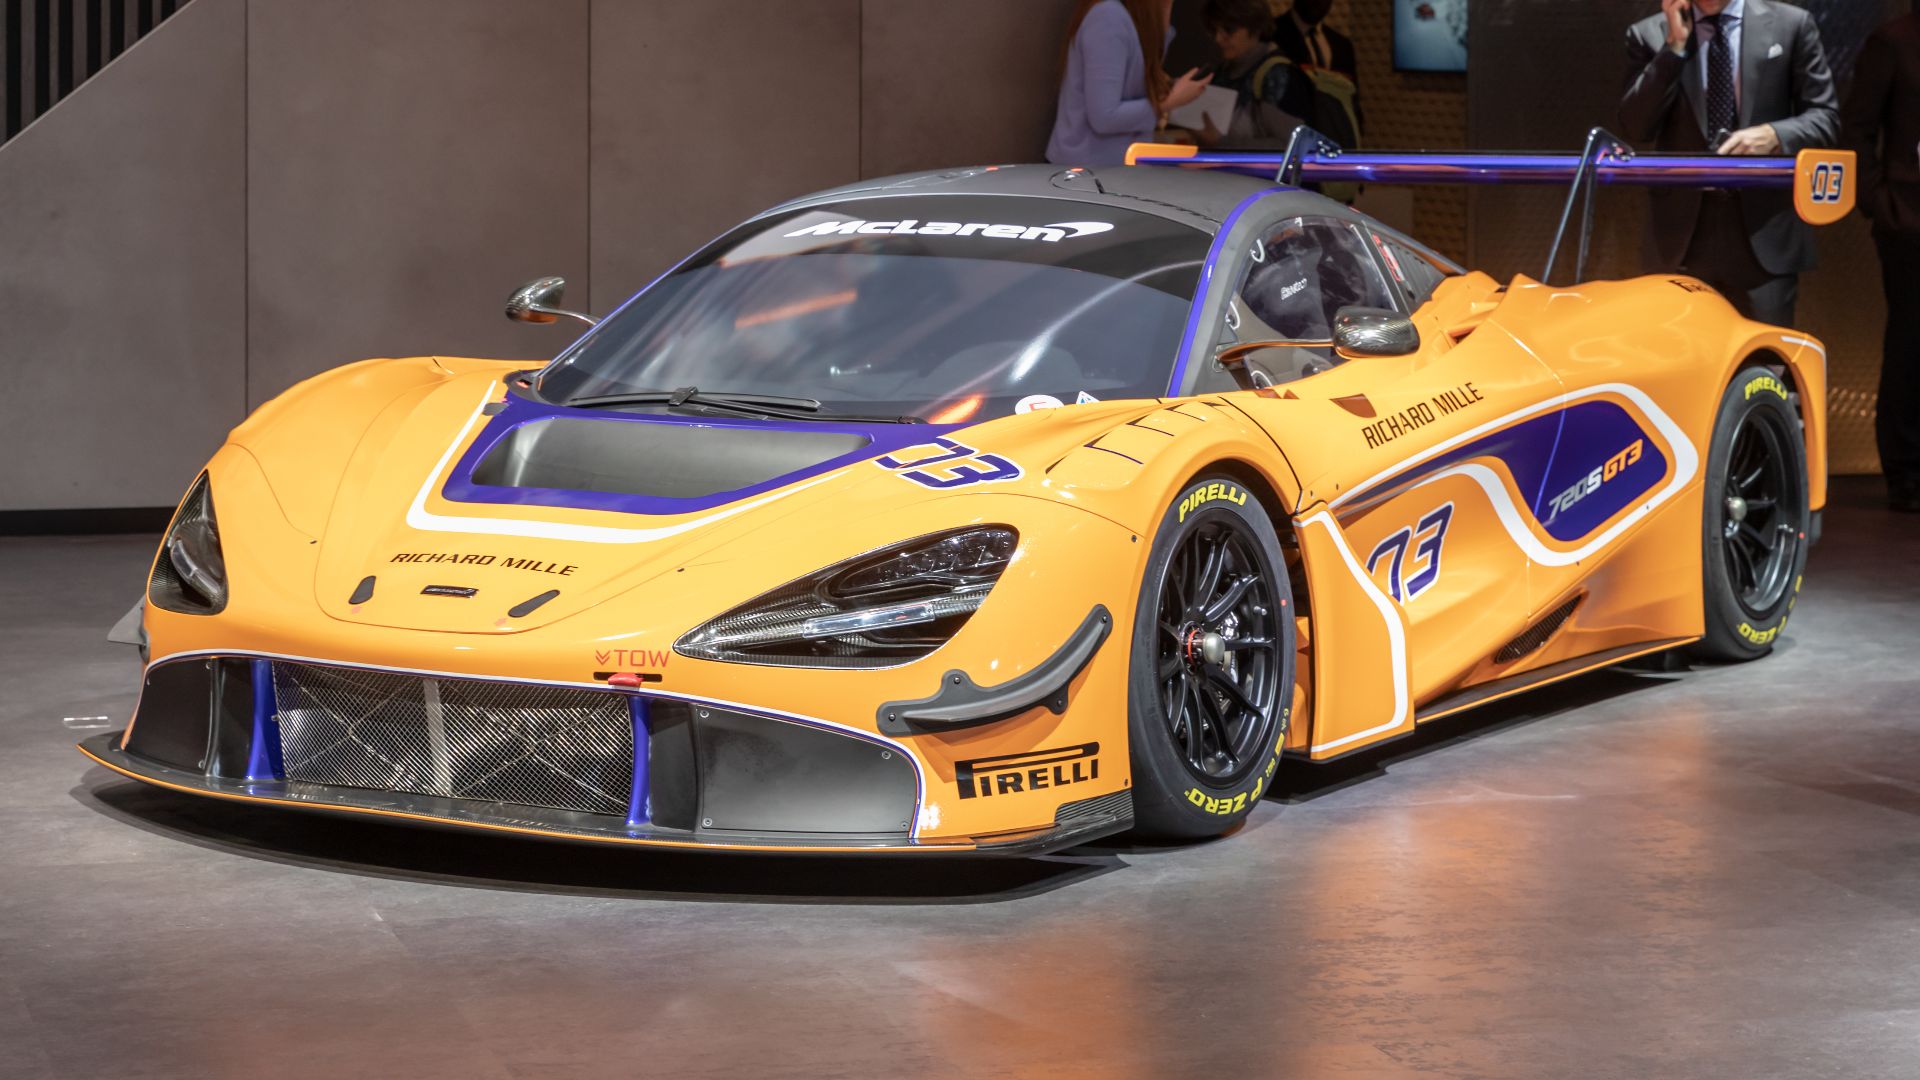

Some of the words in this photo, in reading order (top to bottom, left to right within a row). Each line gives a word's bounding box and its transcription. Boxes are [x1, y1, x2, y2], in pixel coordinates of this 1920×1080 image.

[1812, 162, 1844, 204] 03
[784, 219, 1067, 242] McLaren
[1745, 376, 1787, 400] PIRELLI
[1361, 402, 1436, 449] RICHARD
[1431, 382, 1485, 417] MILLE
[1179, 483, 1248, 523] PIRELLI
[389, 553, 497, 566] RICHARD
[499, 557, 579, 577] MILLE
[1738, 622, 1777, 644] ZERO
[614, 650, 671, 668] TOW
[954, 741, 1100, 800] PIRELLI
[1187, 787, 1248, 815] ZERO
[1250, 776, 1263, 802] P
